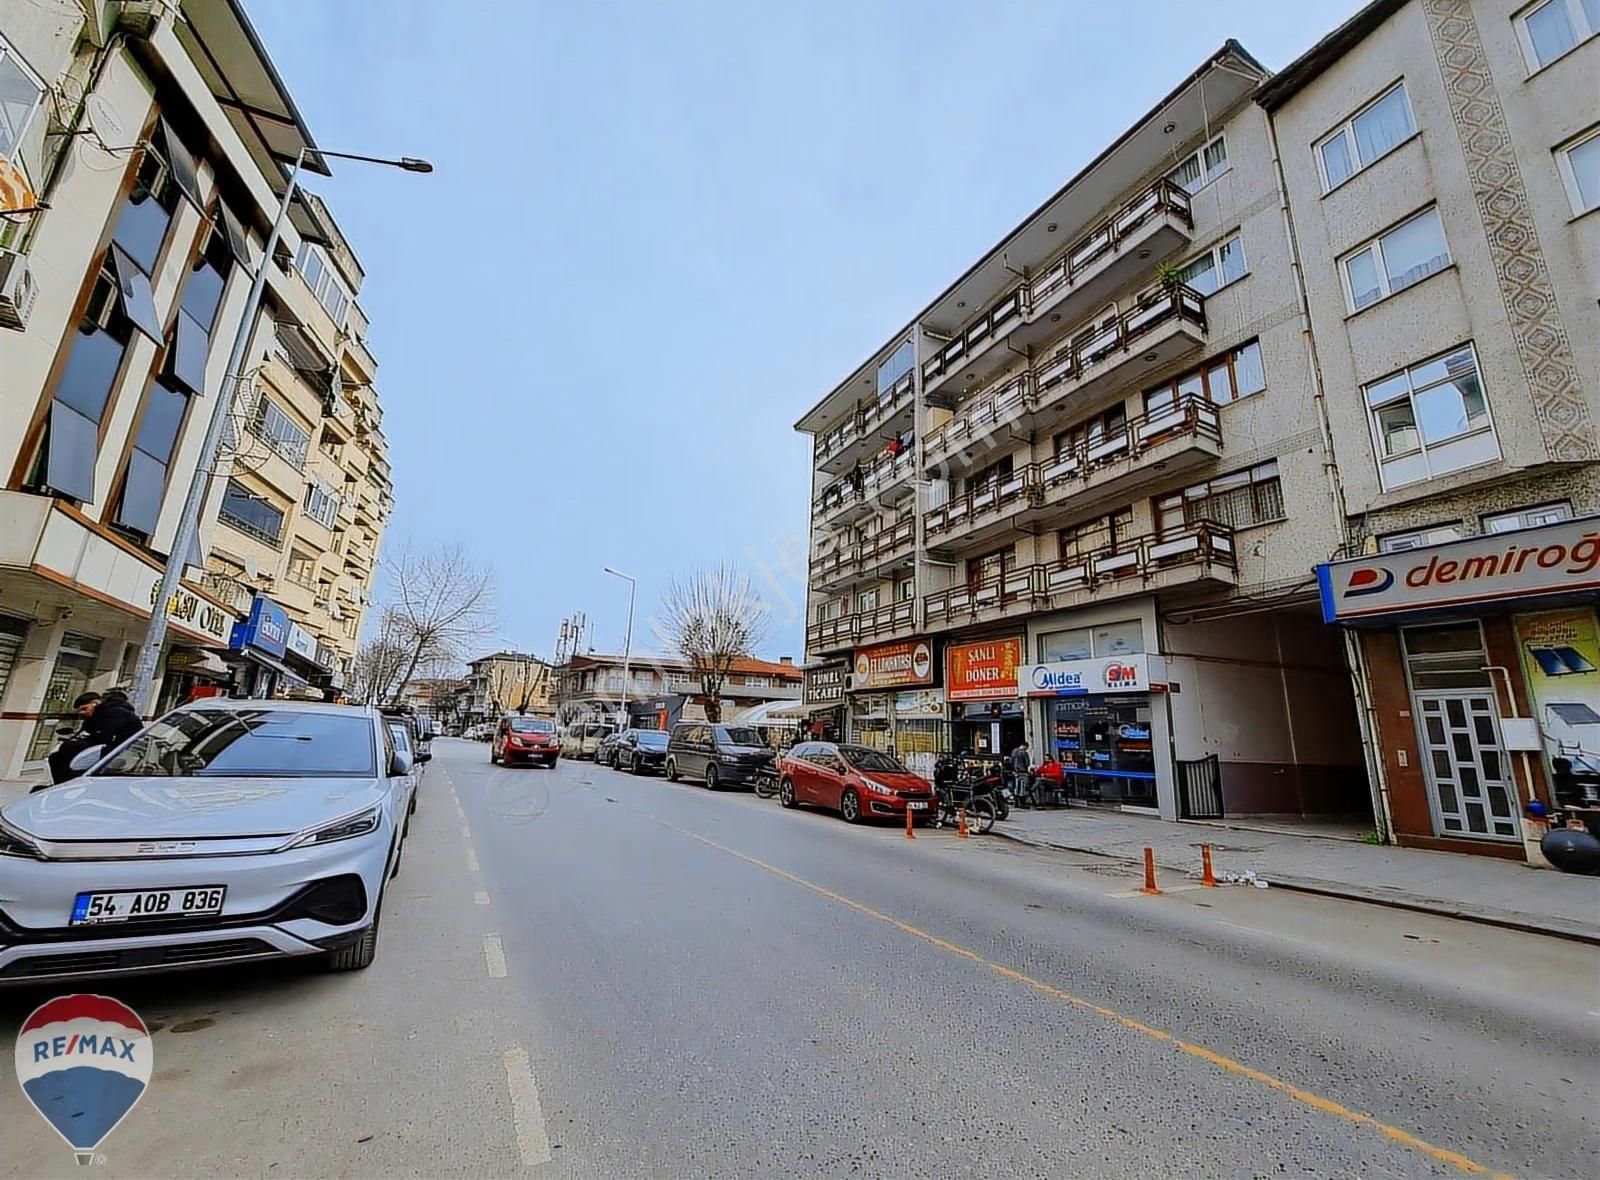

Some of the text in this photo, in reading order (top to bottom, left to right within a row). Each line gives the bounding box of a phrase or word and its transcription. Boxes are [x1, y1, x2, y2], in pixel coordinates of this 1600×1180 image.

[88, 890, 221, 917] 54 AOB 836
